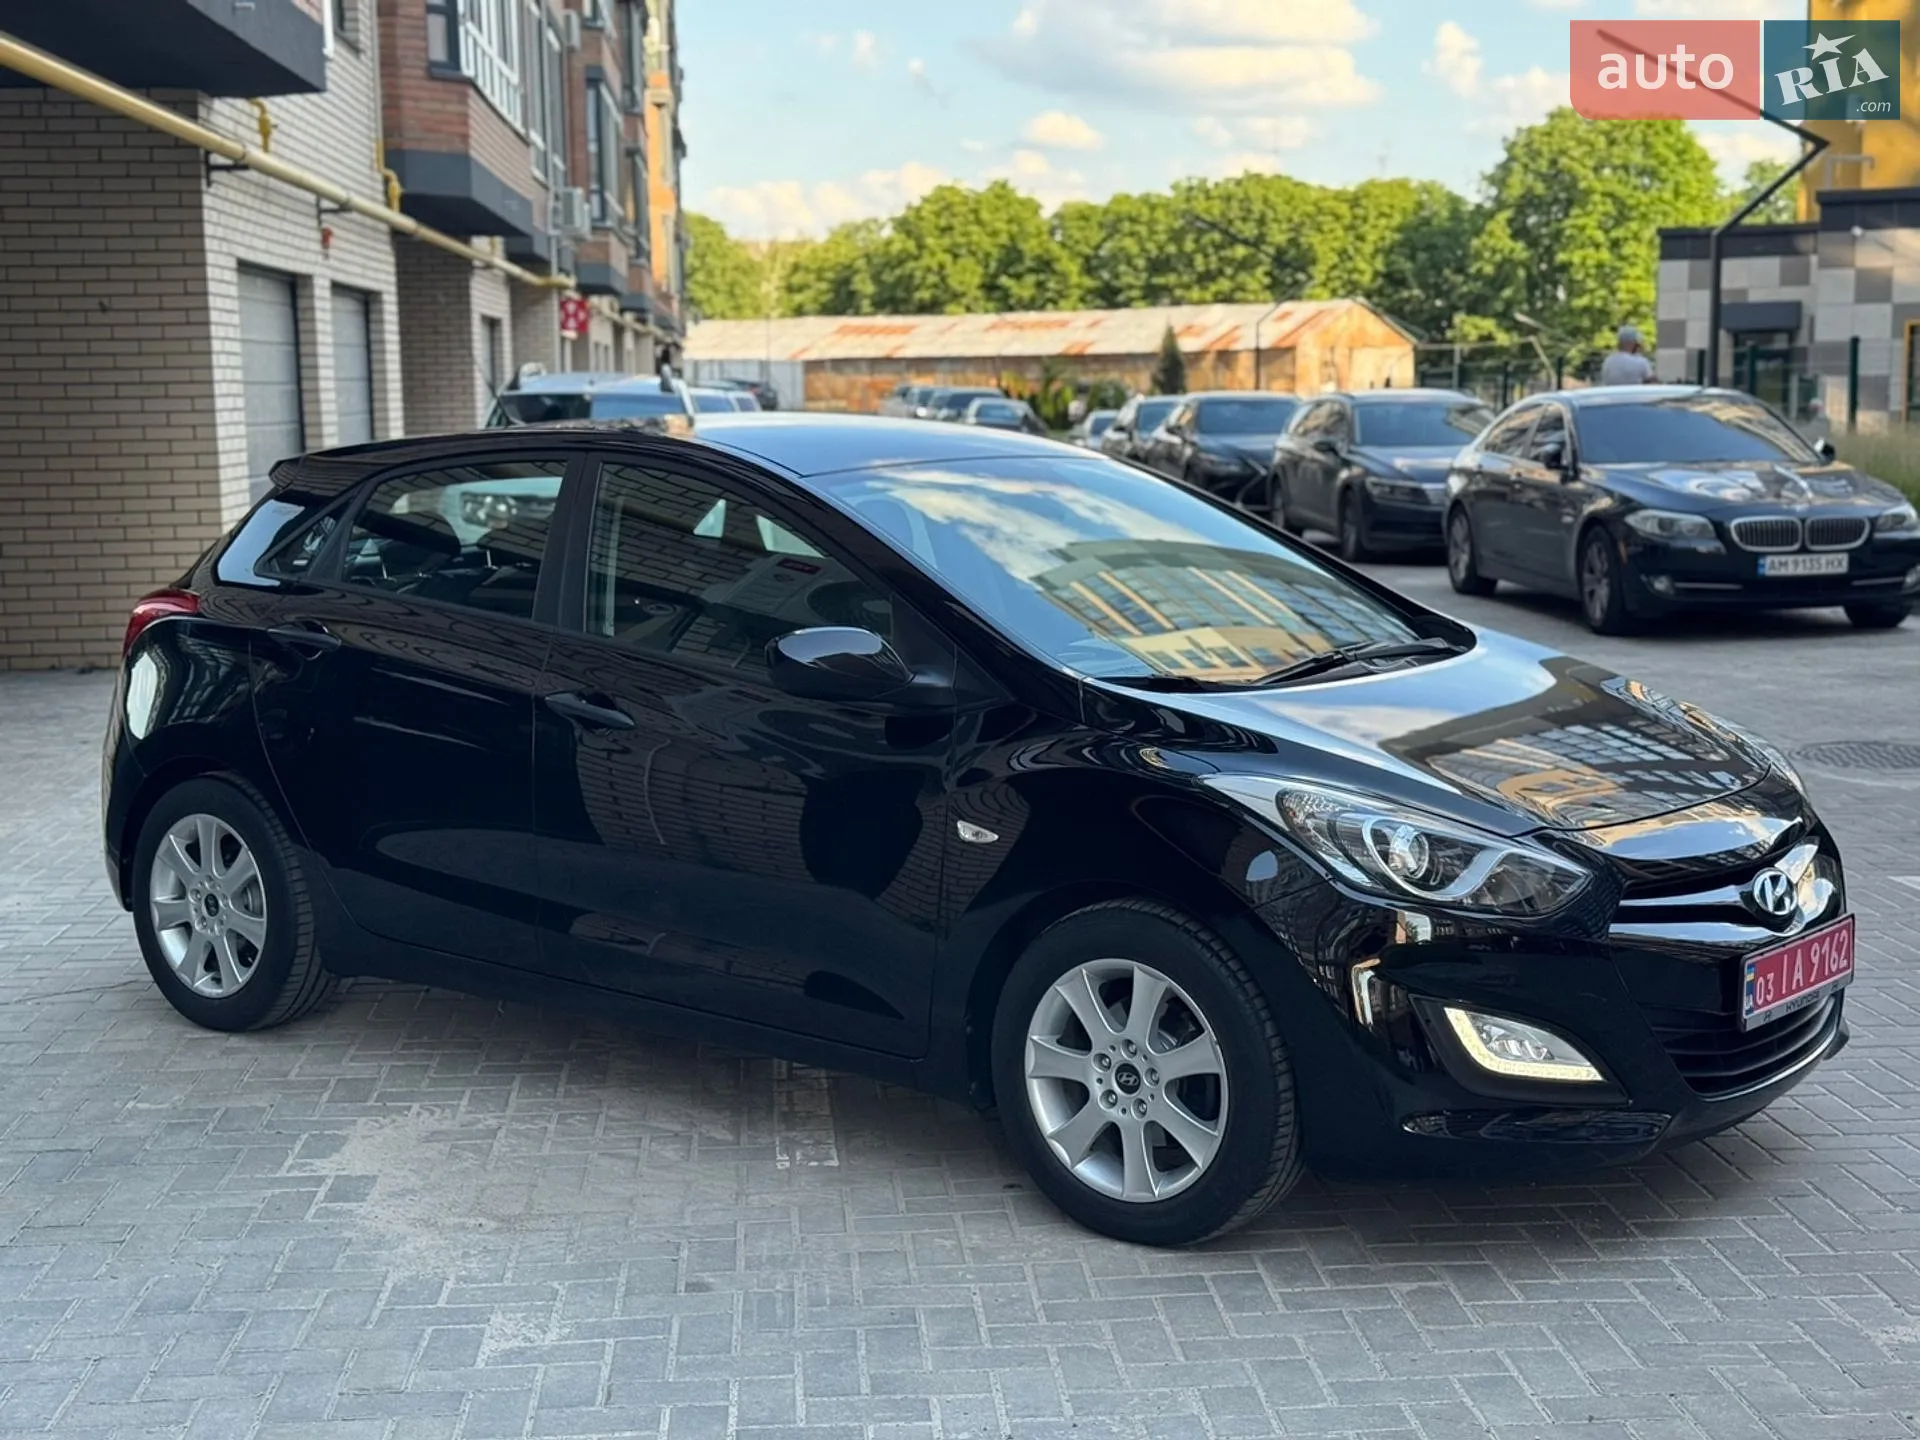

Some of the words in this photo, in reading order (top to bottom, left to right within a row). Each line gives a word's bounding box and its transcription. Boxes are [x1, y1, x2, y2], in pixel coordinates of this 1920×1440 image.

[1768, 558, 1789, 572] AM
[1756, 972, 1775, 1006] 03
[1782, 948, 1803, 994] IA
[1810, 930, 1848, 983] 9162
